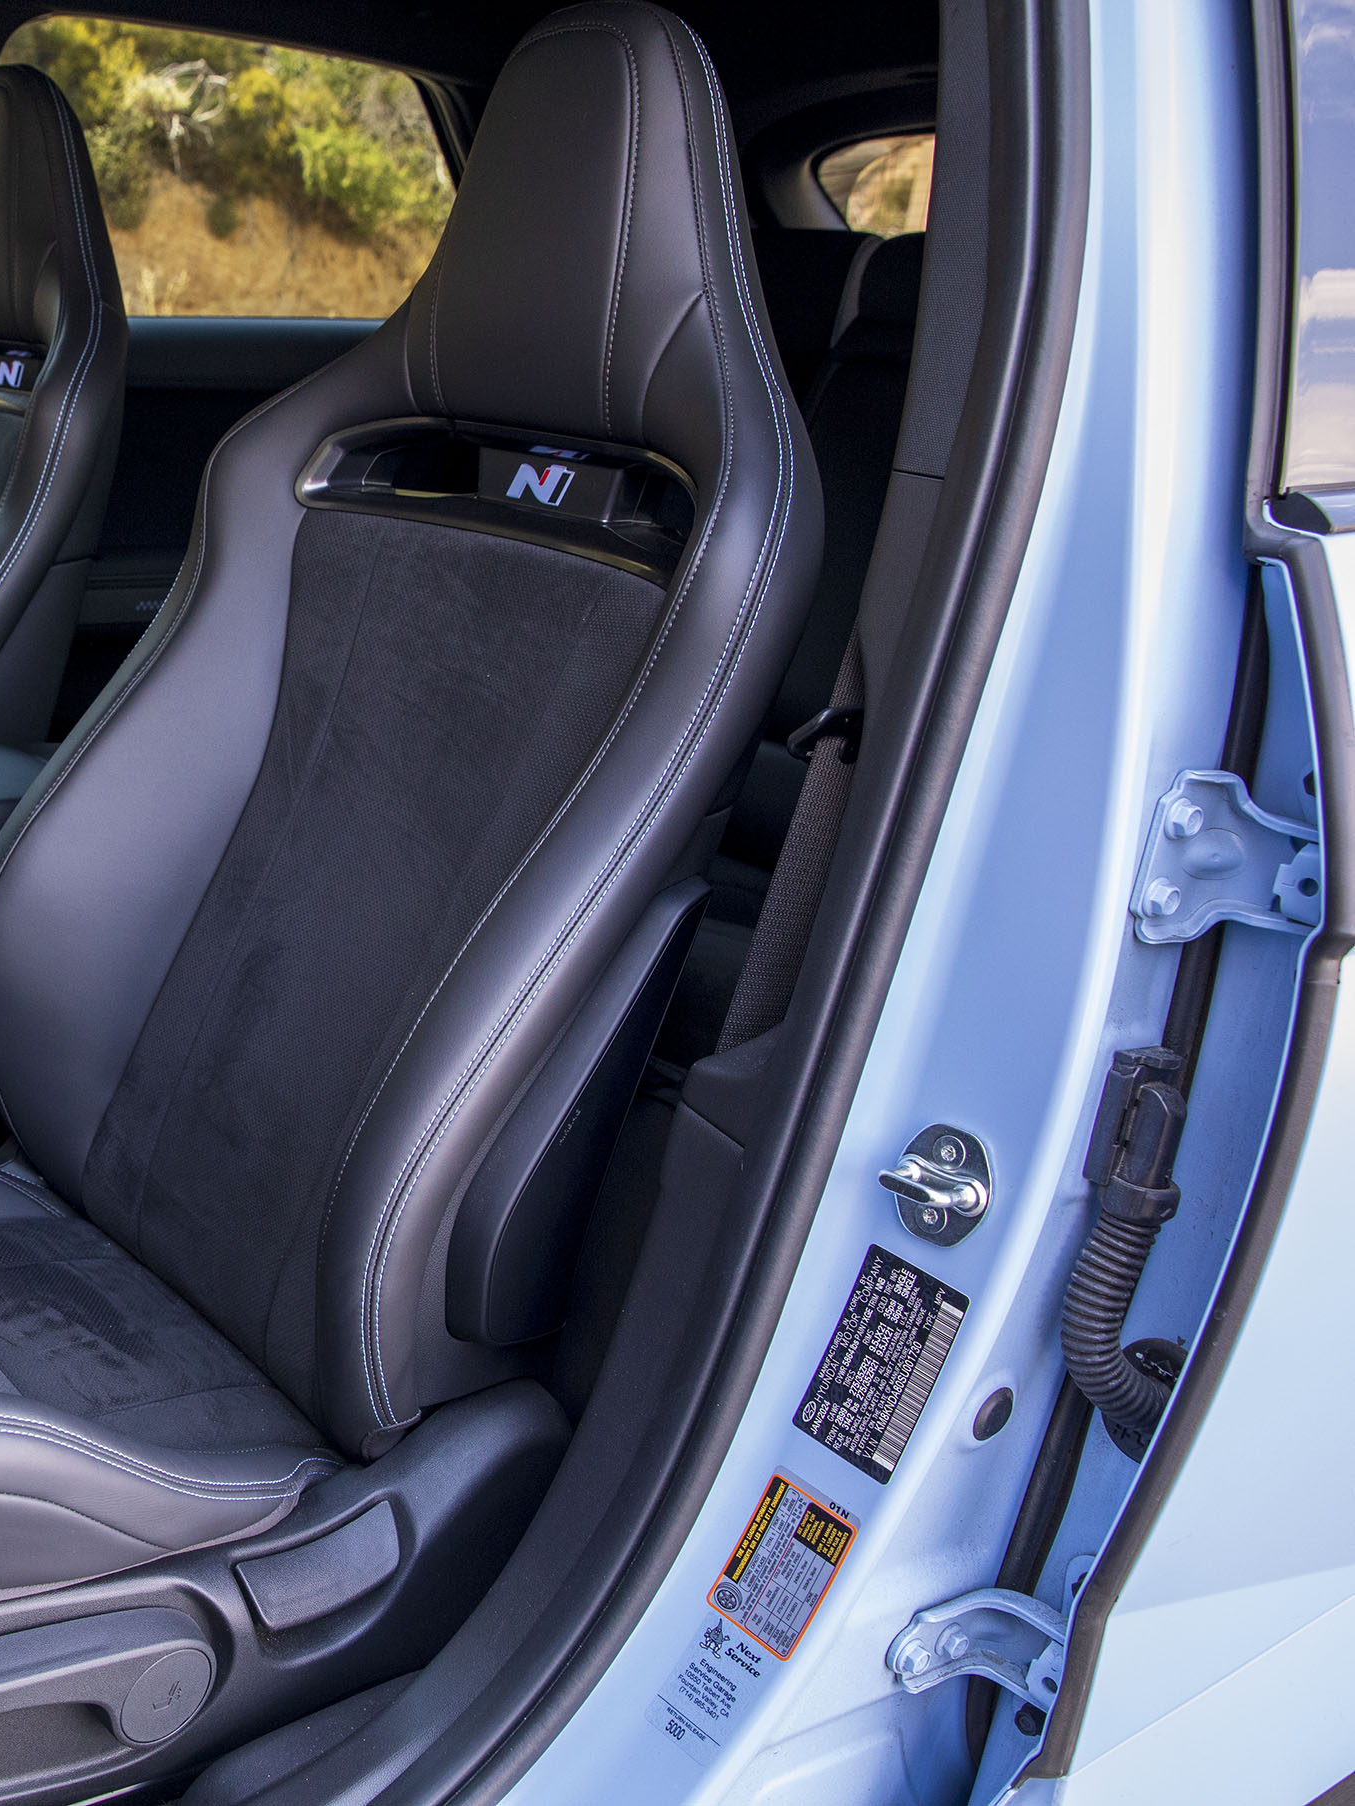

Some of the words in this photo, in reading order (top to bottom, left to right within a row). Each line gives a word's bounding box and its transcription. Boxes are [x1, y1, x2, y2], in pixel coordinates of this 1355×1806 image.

[889, 1266, 901, 1282] INFL
[884, 1281, 895, 1296] TIRE
[876, 1295, 889, 1314] COLD
[914, 1307, 927, 1326] ABOVE
[814, 1358, 840, 1404] HYUNDAI
[839, 1312, 861, 1348] MOTOR
[858, 1255, 885, 1304] COMPANY
[818, 1330, 844, 1379] MANUFACTURED
[842, 1317, 849, 1326] IN
[848, 1289, 862, 1312] KOREA
[859, 1274, 868, 1285] BY
[834, 1365, 847, 1384] GVWR
[842, 1348, 855, 1368] 5864
[850, 1339, 860, 1351] lbs
[868, 1293, 879, 1309] TRIM
[862, 1328, 874, 1346] RIMS
[906, 1326, 919, 1346] SHOWN
[825, 1424, 839, 1446] FRONT
[834, 1406, 848, 1426] 2899
[842, 1396, 853, 1409] lbs
[848, 1354, 872, 1396] 275/35ZR21
[868, 1322, 887, 1353] 9.5JX21
[883, 1298, 898, 1320] 35psi
[893, 1267, 910, 1295] SINGLE
[833, 1432, 845, 1451] REAR
[841, 1412, 855, 1431] 3142
[850, 1401, 860, 1413] lbs
[856, 1359, 879, 1401] 275/35ZR21
[875, 1326, 894, 1357] 9.5JX21
[890, 1302, 906, 1325] 36psi
[900, 1271, 917, 1299] SINGLE
[844, 1436, 852, 1448] THIS
[850, 1414, 862, 1435] VEHICLE
[860, 1385, 876, 1413] CONFORMS
[873, 1376, 880, 1384] TO
[877, 1364, 885, 1375] ALL
[907, 1285, 920, 1308] FEDERAL
[875, 1339, 923, 1434] KM8KNDA80SU001730
[922, 1311, 936, 1331] TYPE
[933, 1287, 946, 1306] MPV
[888, 1345, 910, 1385] MANUFACTURE
[843, 1368, 856, 1388] TIRES
[849, 1432, 861, 1452] MOTOR
[858, 1411, 871, 1433] VEHICLE
[868, 1391, 881, 1411] SAFETY
[877, 1378, 887, 1391] AND
[883, 1361, 895, 1378] THEFT
[890, 1329, 909, 1362] PREVENTION
[905, 1297, 923, 1329] STANDARDS
[878, 1393, 888, 1409] DATE
[884, 1384, 892, 1394] OF
[809, 1399, 831, 1436] JAN/2024
[826, 1402, 840, 1422] GAWR
[868, 1419, 876, 1429] ON
[873, 1408, 881, 1419] THE
[858, 1428, 871, 1449] EFFECT
[855, 1448, 862, 1456] IN
[736, 1547, 745, 1559] TIRE
[741, 1539, 749, 1549] AND
[746, 1522, 758, 1540] LOADING
[754, 1496, 771, 1523] INFORMATION
[753, 1532, 761, 1541] LES
[757, 1519, 768, 1533] PNEUS
[764, 1512, 771, 1520] ET
[801, 1522, 812, 1538] MANUAL
[810, 1520, 826, 1545] INFORMATION
[816, 1542, 824, 1553] VOIR
[822, 1546, 828, 1554] DE
[724, 1646, 762, 1679] Service
[736, 1641, 762, 1665] Next
[684, 1669, 701, 1685] 10550
[701, 1683, 720, 1701] Talbert
[688, 1662, 713, 1684] Service
[711, 1681, 737, 1704] Garage
[699, 1658, 738, 1692] Engineering
[677, 1674, 702, 1696] Fountain
[700, 1692, 720, 1712] Valley,
[719, 1708, 731, 1719] CA
[678, 1685, 695, 1701] (714)
[664, 1719, 686, 1741] 5000
[666, 1706, 686, 1725] RETURN
[684, 1721, 707, 1742] MILEAGE
